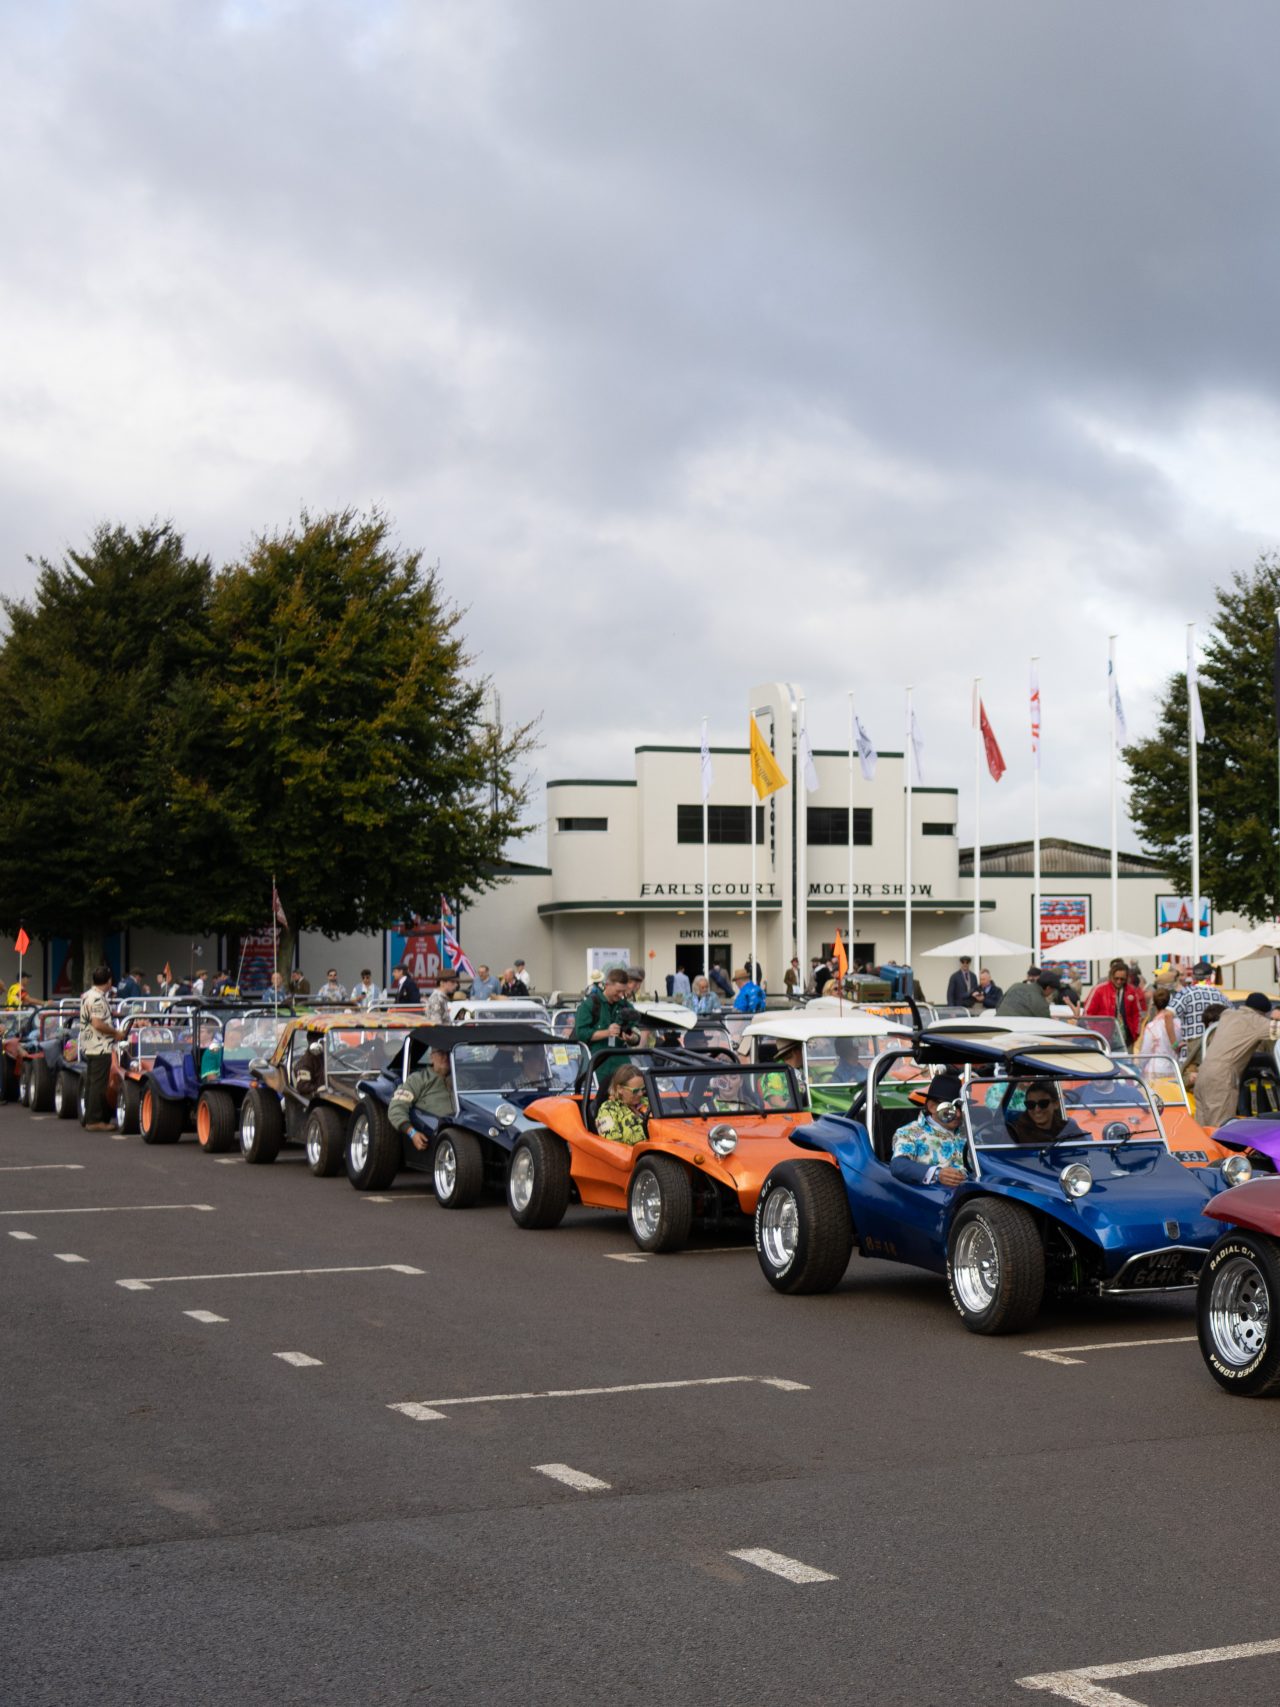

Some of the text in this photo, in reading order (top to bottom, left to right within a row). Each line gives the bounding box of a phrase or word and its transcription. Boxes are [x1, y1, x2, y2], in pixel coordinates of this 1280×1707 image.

[641, 884, 776, 897] EARLS COURT
[809, 883, 872, 895] MOTOR
[679, 929, 729, 938] ENTRANCE
[1210, 1245, 1241, 1271] RADIAL
[1209, 1342, 1267, 1379] COOPER COBRA
